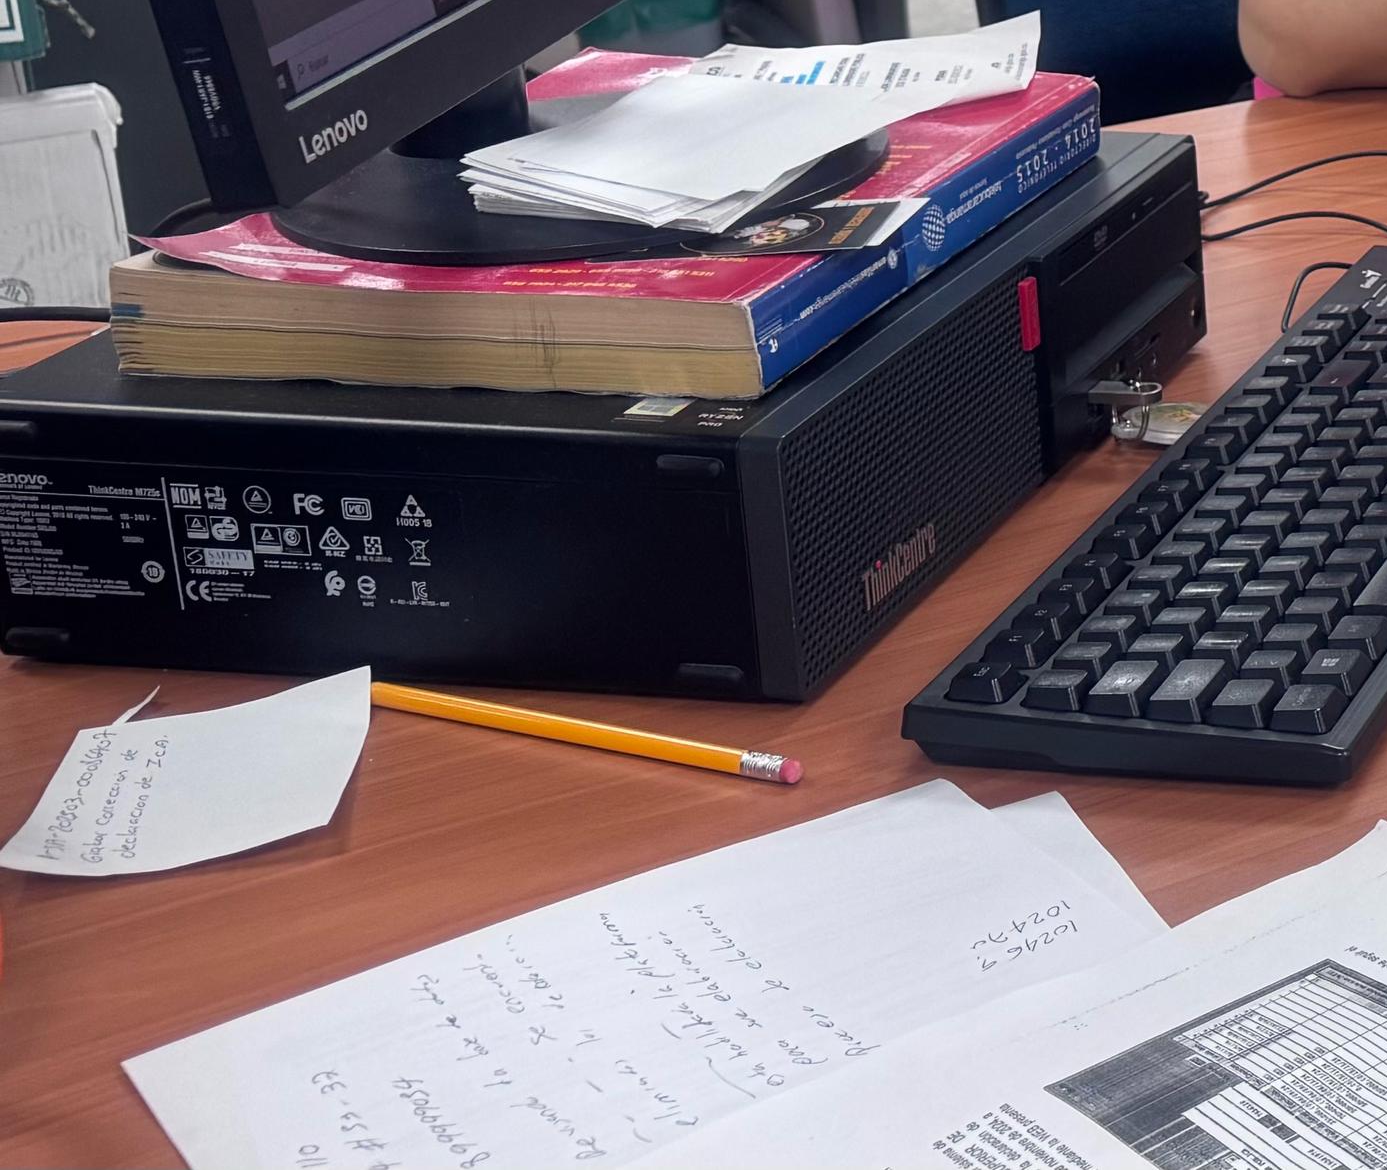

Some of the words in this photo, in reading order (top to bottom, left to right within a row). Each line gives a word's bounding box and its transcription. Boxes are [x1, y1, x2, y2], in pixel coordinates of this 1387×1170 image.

[298, 106, 370, 165] Lenovo
[1064, 117, 1096, 150] 2014
[1016, 149, 1050, 183] 2015
[698, 413, 745, 421] RYZEN
[88, 485, 134, 496] ThinkCentre
[171, 487, 201, 506] NOM
[862, 522, 938, 613] ThinkCentre
[120, 749, 138, 761] de
[134, 776, 153, 789] de
[997, 1101, 1035, 1127] presenta
[963, 1120, 981, 1132] de
[985, 1114, 1014, 1135] 2024,
[1025, 1123, 1052, 1141] WEB
[931, 1138, 947, 1150] de
[946, 1129, 967, 1144] DE
[1005, 1129, 1023, 1142] de
[1044, 1136, 1060, 1148] la
[976, 1129, 1021, 1162] declaración
[1016, 1136, 1060, 1168] noviembre
[941, 1146, 975, 1170] sistema
[1017, 1159, 1033, 1170] la
